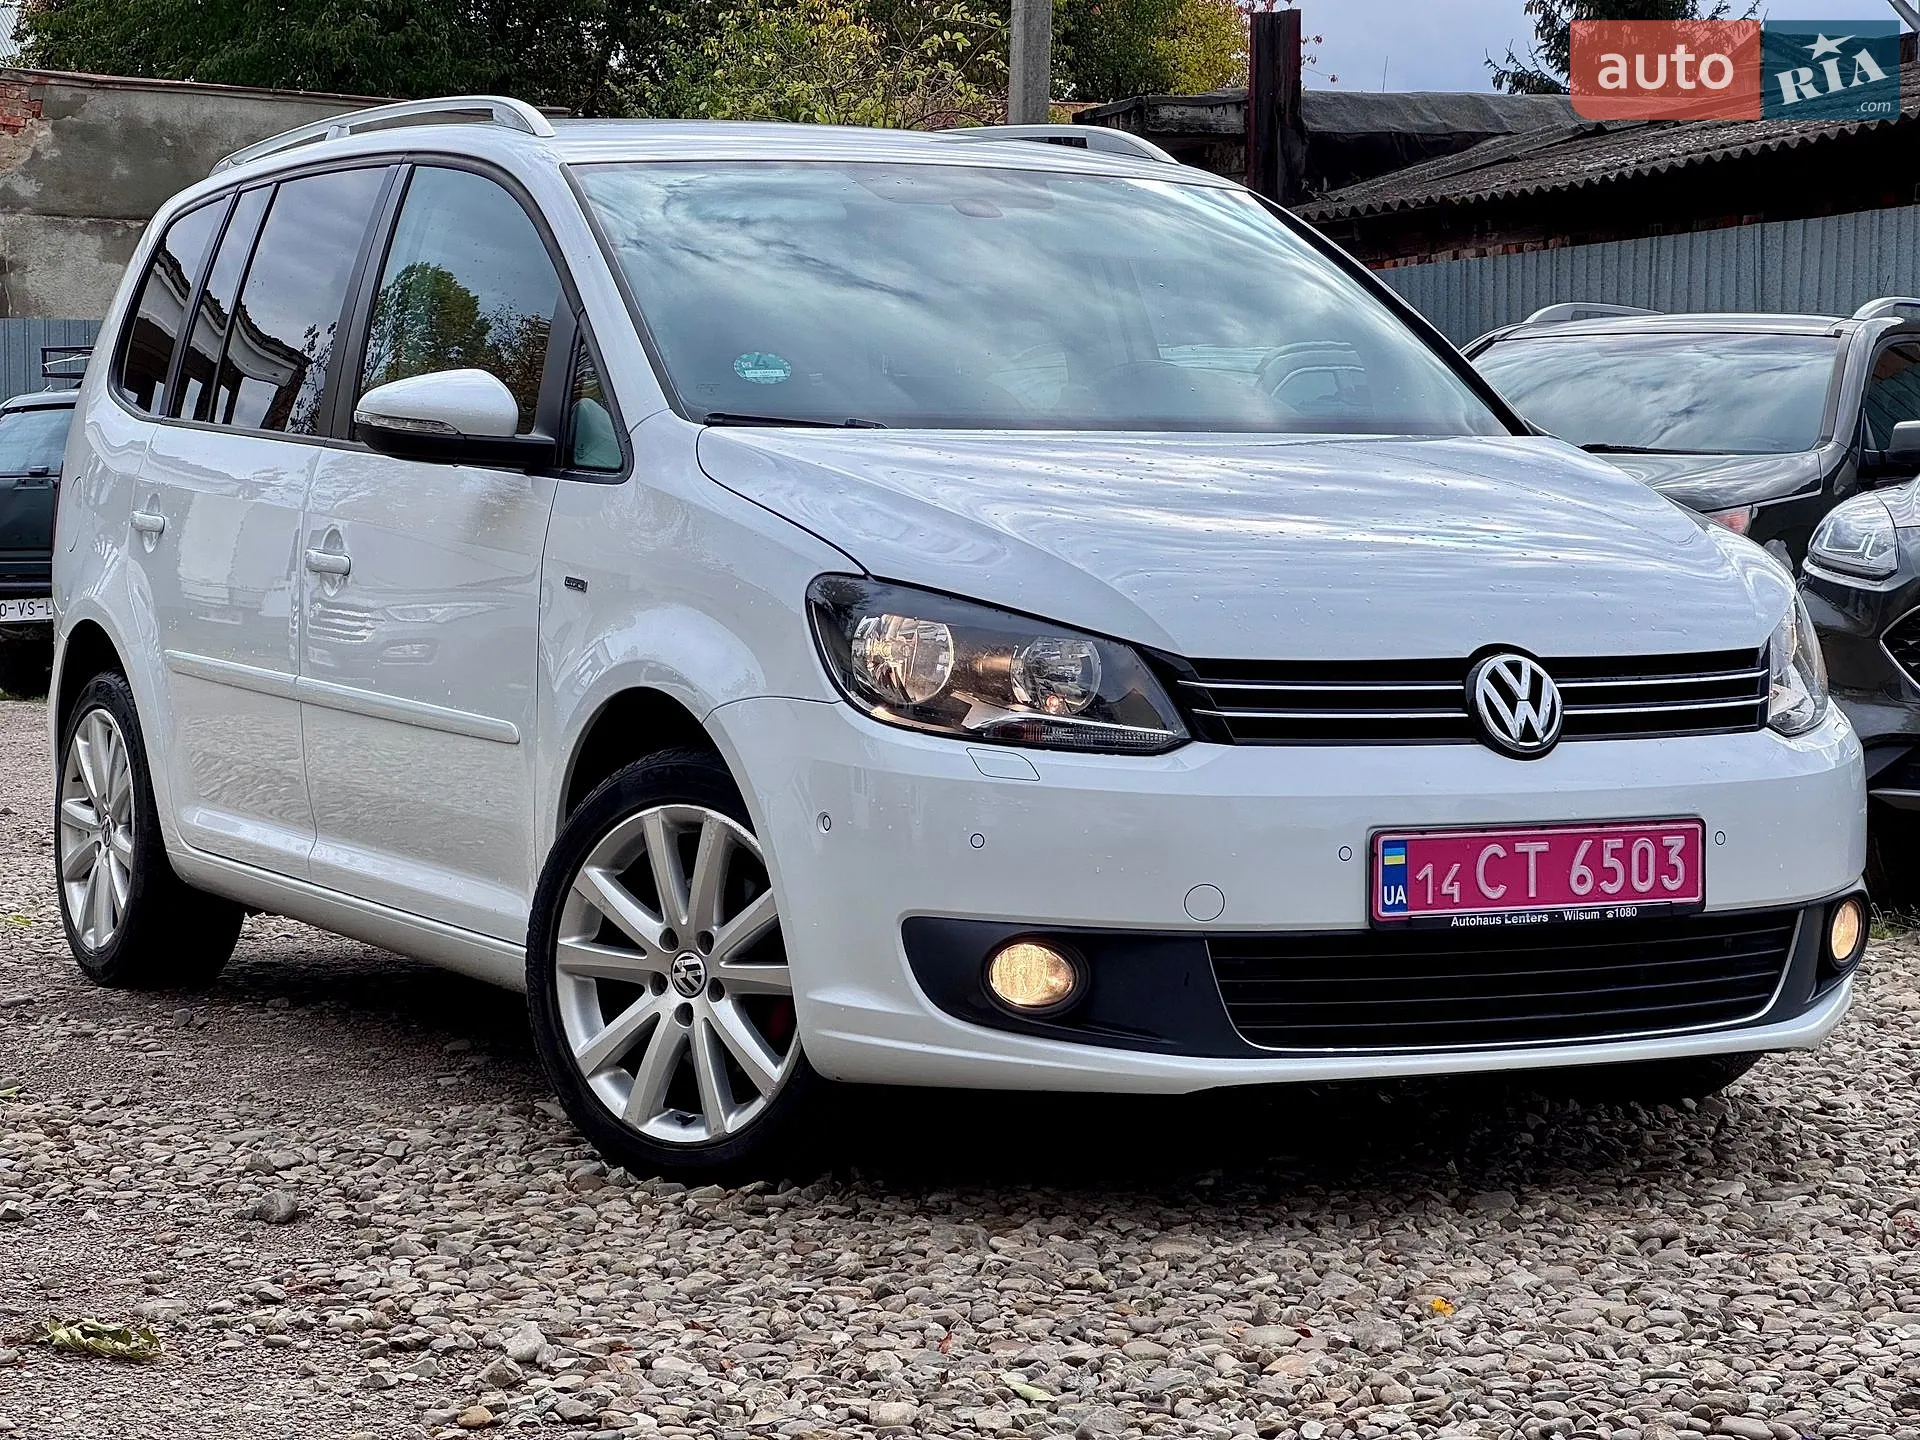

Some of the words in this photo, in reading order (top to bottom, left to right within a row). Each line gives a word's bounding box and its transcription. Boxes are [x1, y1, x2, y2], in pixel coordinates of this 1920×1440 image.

[1476, 654, 1562, 748] VW
[1415, 863, 1461, 904] 14
[1475, 841, 1550, 900] CT
[1569, 835, 1686, 896] 6503
[1383, 884, 1407, 906] UA
[1450, 913, 1502, 927] Autohaus
[1504, 912, 1549, 925] Lenters
[1563, 909, 1600, 921] Wilsum
